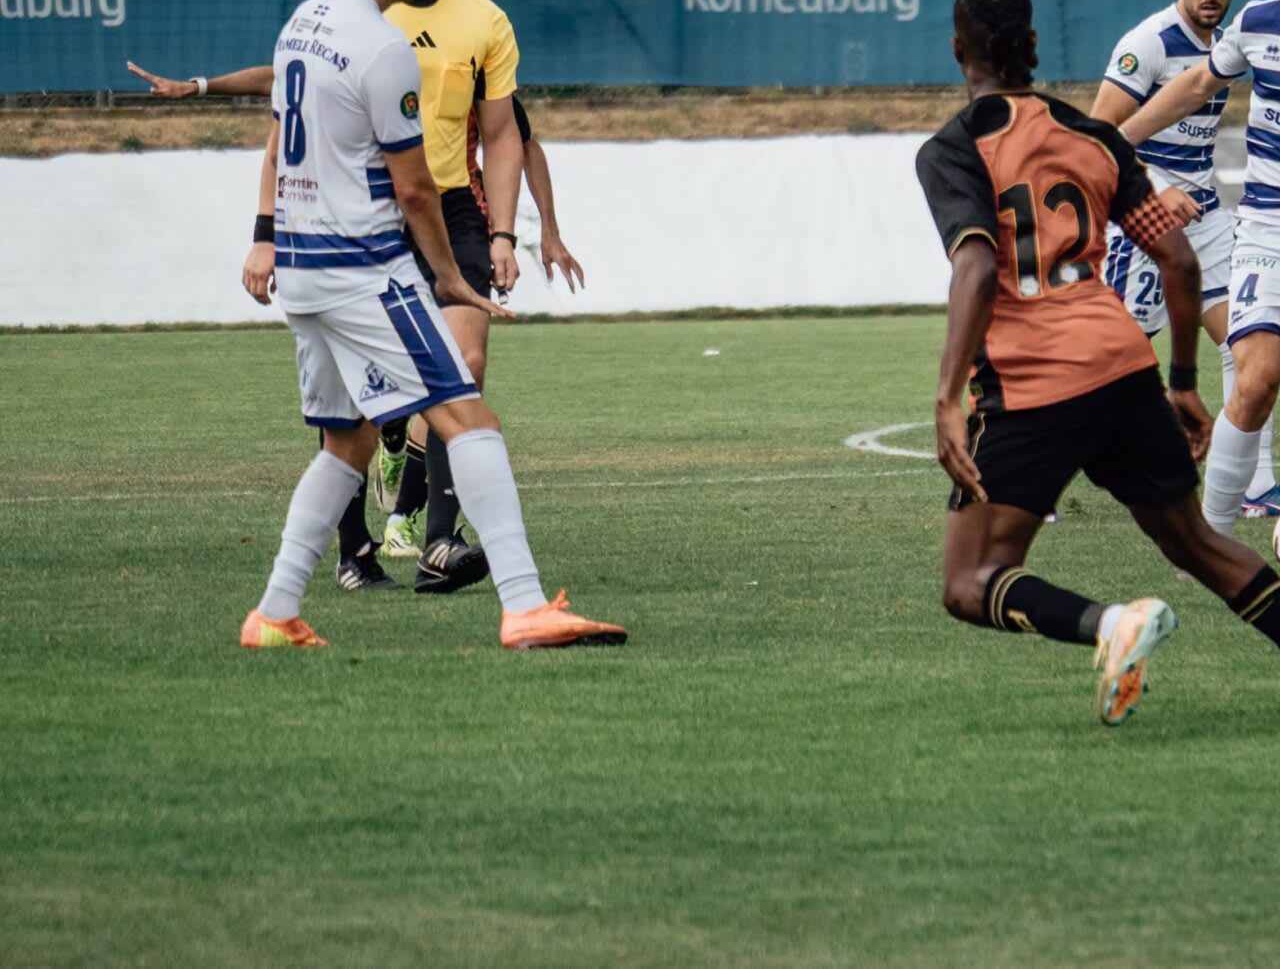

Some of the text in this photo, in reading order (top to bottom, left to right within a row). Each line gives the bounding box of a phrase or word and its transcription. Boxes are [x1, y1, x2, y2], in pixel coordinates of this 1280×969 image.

[284, 59, 307, 166] 8
[998, 179, 1096, 299] 12
[1236, 273, 1260, 307] 4
